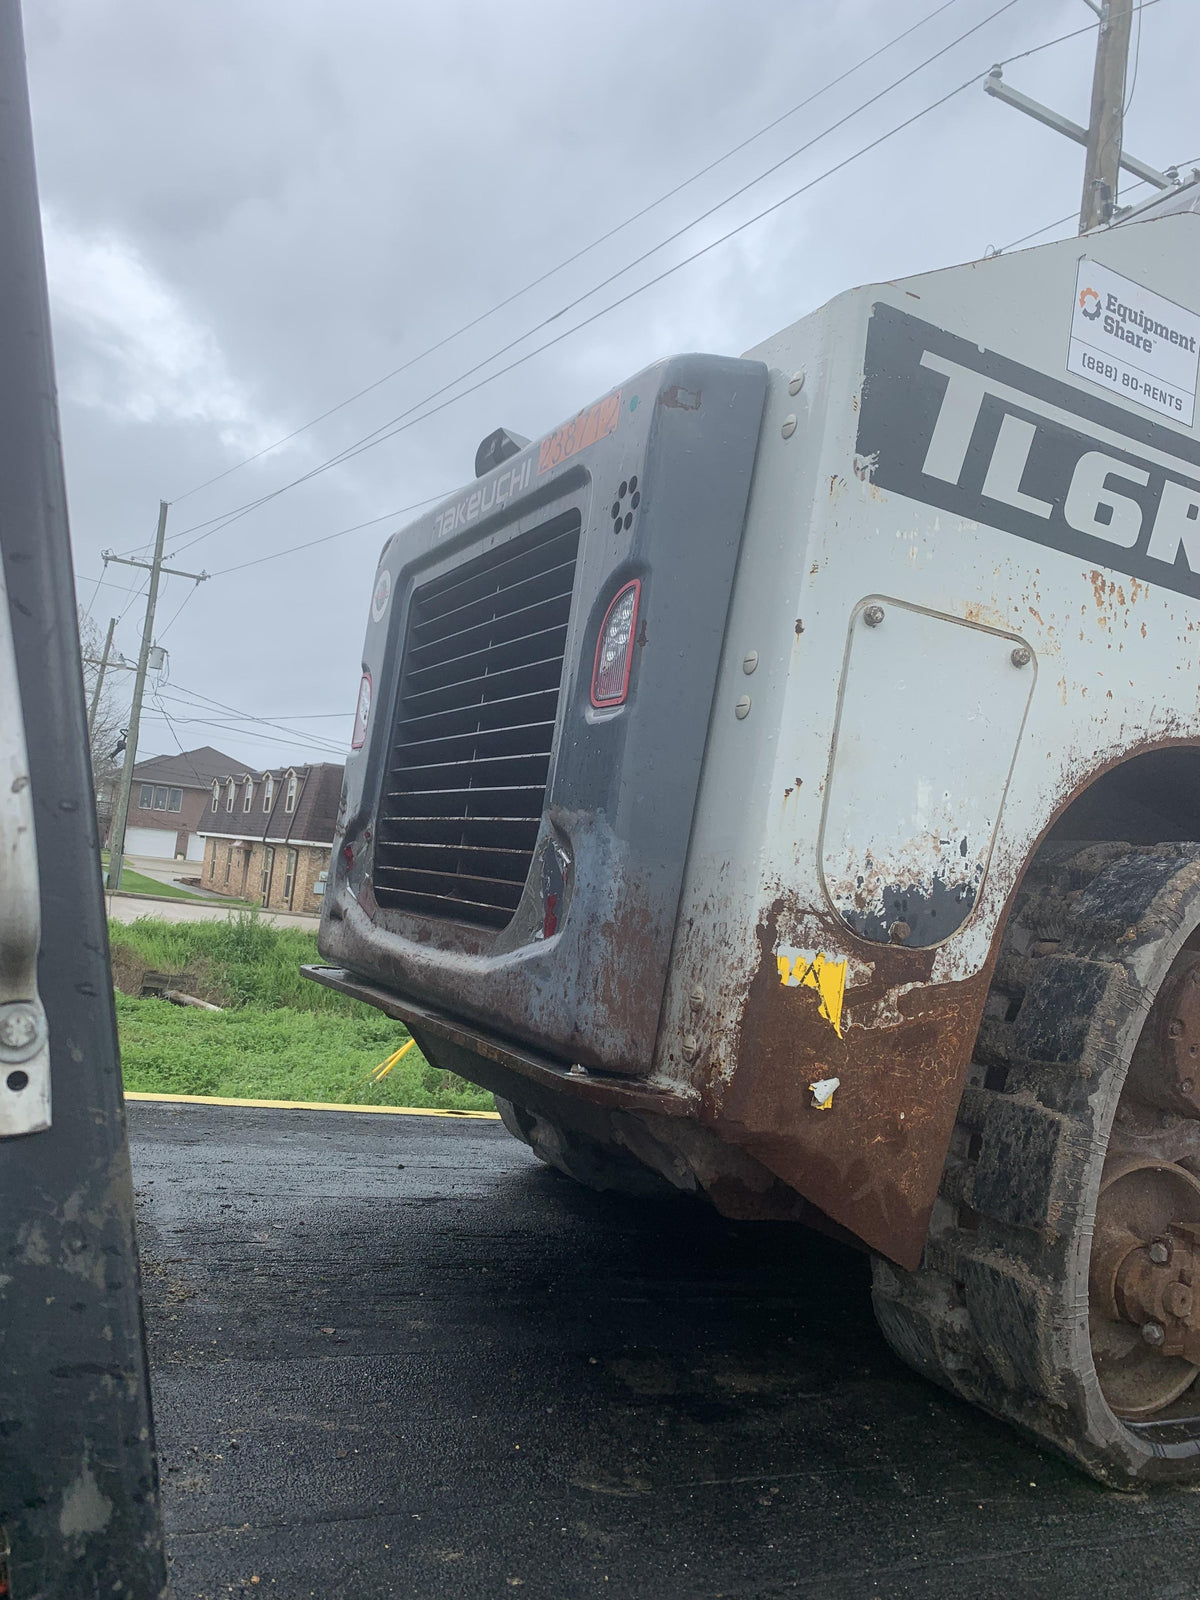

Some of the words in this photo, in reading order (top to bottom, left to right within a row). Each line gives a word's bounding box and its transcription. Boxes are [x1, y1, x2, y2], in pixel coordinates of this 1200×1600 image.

[1103, 315, 1153, 353] Share
[1105, 293, 1197, 354] Equipment
[1082, 352, 1118, 381] (888)
[1121, 373, 1183, 411] 80-RENTS
